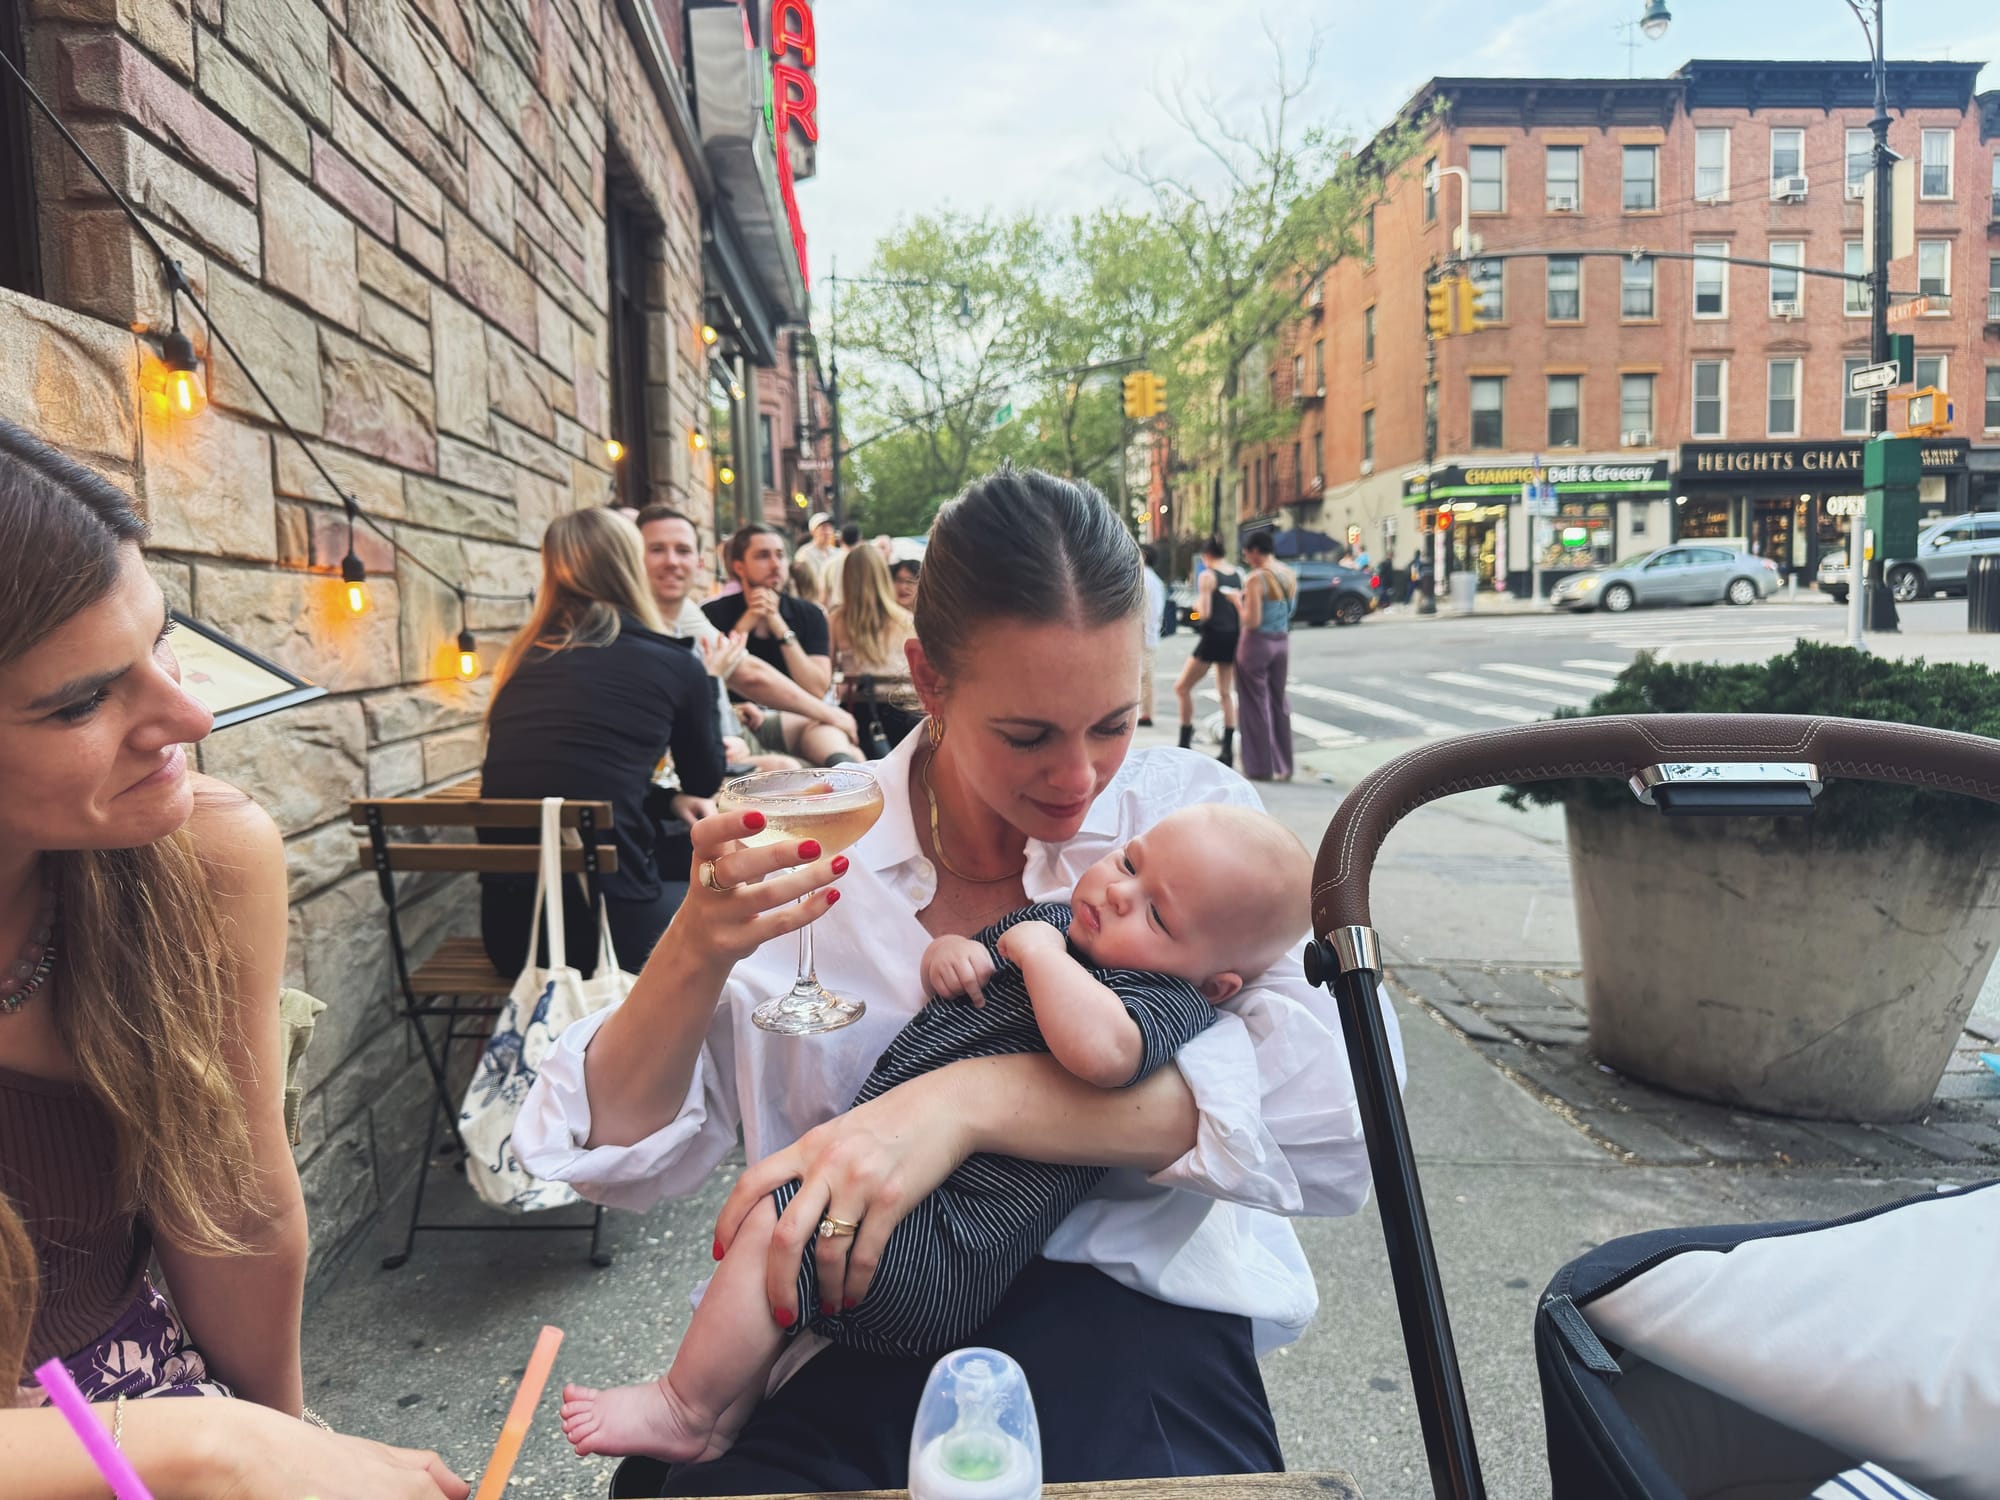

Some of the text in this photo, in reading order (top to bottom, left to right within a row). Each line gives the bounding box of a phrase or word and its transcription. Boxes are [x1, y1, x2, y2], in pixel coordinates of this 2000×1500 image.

[1697, 450, 1862, 472] HEIGHTS CHAT
[1465, 467, 1547, 485] CHAMPION
[1578, 465, 1592, 482] &
[1593, 465, 1654, 484] Grocery
